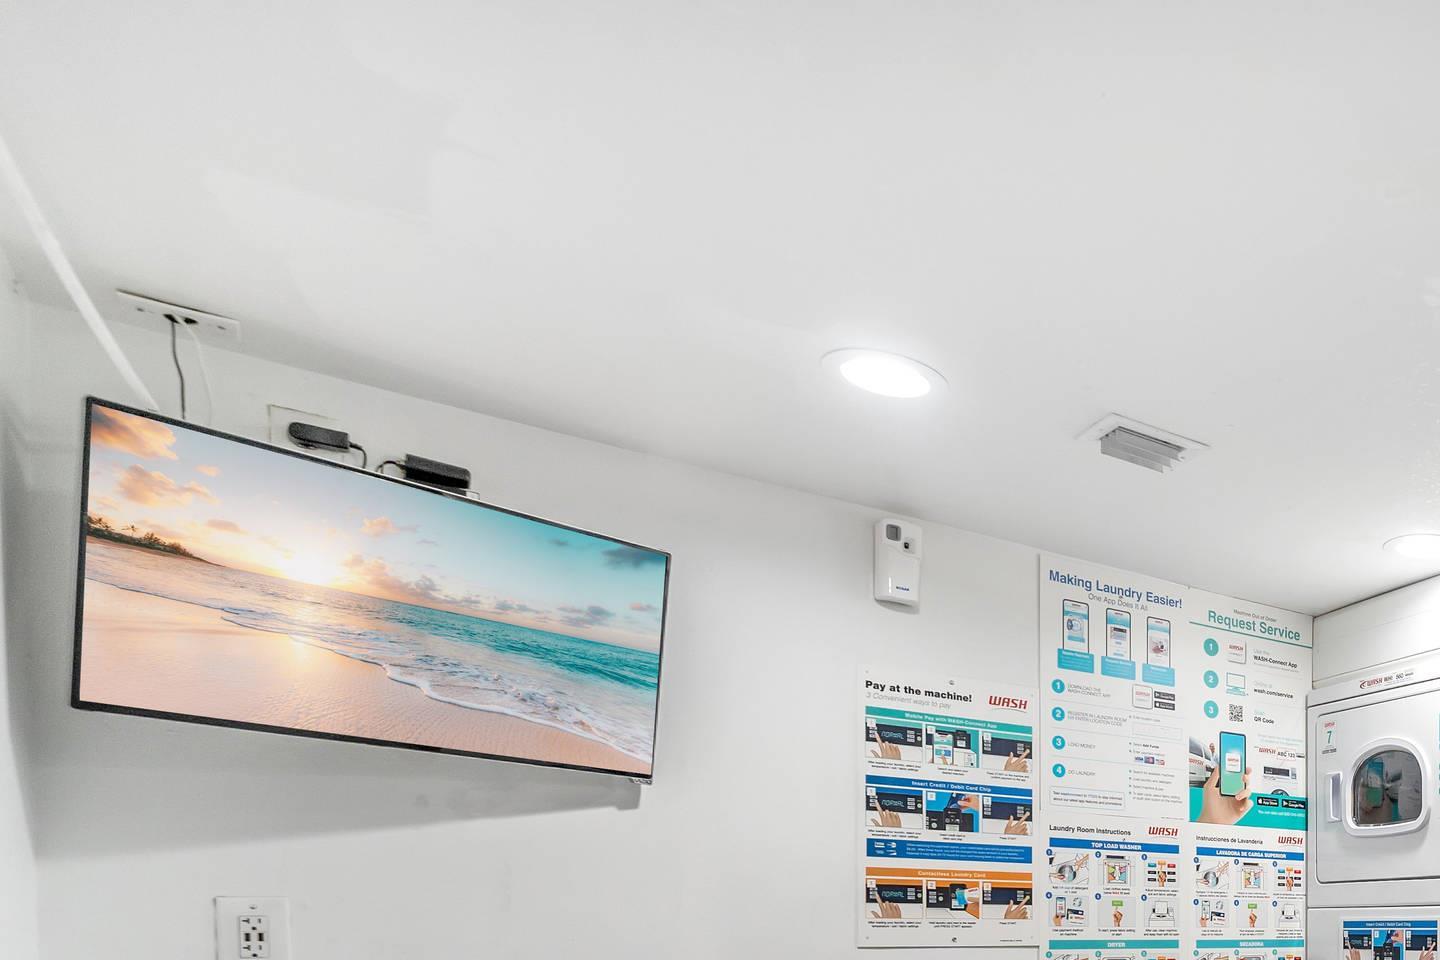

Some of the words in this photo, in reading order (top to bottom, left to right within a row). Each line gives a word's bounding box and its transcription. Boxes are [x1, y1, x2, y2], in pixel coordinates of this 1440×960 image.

[1049, 569, 1092, 591] Making
[1096, 579, 1143, 602] Laundry
[1146, 591, 1182, 609] Easier!
[1088, 592, 1102, 602] One
[1103, 596, 1116, 606] App
[1208, 609, 1256, 632] Request
[1259, 621, 1301, 641] Service
[1253, 654, 1288, 667] WASH-Connect
[1288, 660, 1298, 669] App
[865, 680, 886, 692] Pay
[889, 685, 901, 693] at
[904, 686, 922, 696] the
[924, 688, 972, 703] machine!
[873, 692, 912, 704] Convenient
[913, 699, 930, 708] ways
[939, 702, 951, 710] pay
[988, 694, 1028, 710] WASH
[924, 714, 934, 722] Pay
[1262, 717, 1275, 725] Code
[1326, 730, 1333, 744] 7
[911, 780, 929, 788] Insert
[929, 781, 946, 789] Credit
[950, 783, 965, 791] Debit
[966, 785, 981, 793] Card
[1049, 824, 1075, 834] Laundry
[1096, 827, 1131, 836] Instructions
[1148, 826, 1178, 837] WASH
[1195, 835, 1230, 843] Instrucciones
[1277, 835, 1304, 845] WASH
[1104, 842, 1119, 850] LOAD
[1120, 843, 1142, 851] WASHER
[917, 870, 950, 878] Contactless
[951, 871, 973, 880] Laundry
